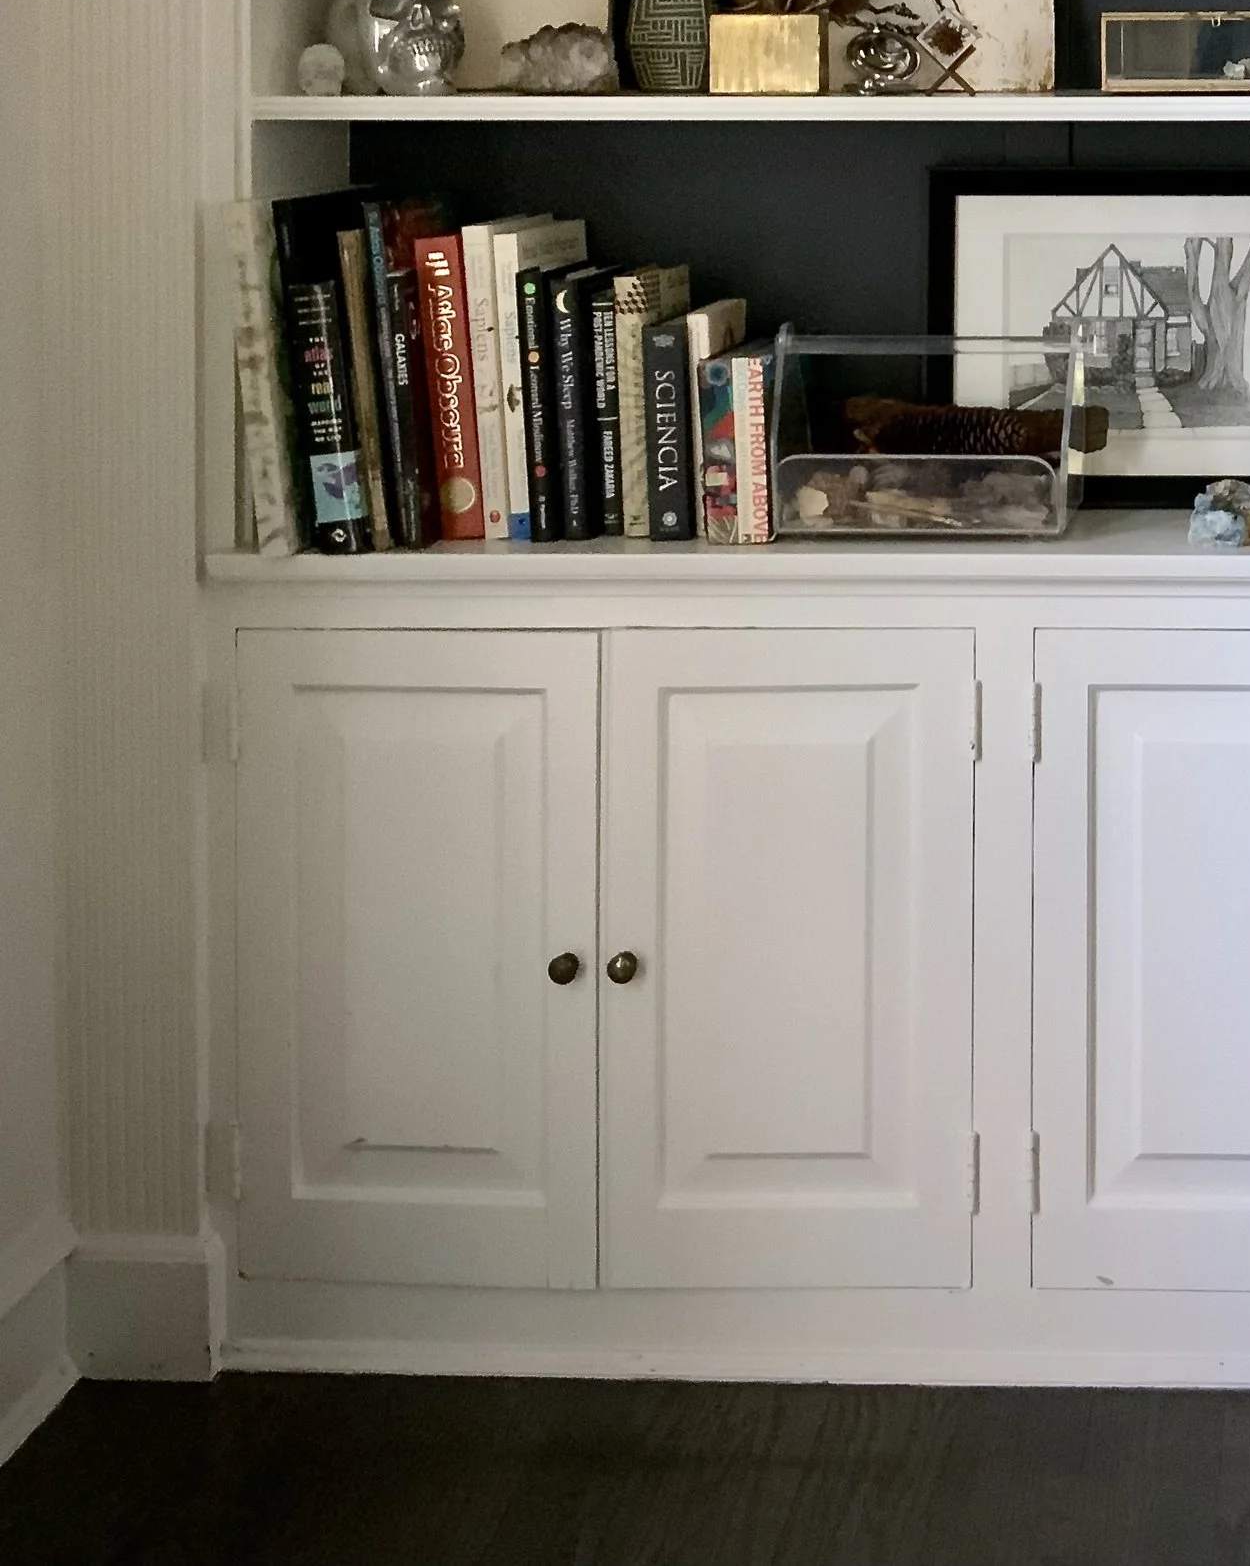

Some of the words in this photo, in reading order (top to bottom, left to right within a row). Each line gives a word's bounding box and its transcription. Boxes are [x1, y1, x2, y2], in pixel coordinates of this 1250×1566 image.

[427, 284, 456, 352] Atlas
[471, 298, 490, 362] Sapiens
[502, 312, 518, 364] Sapiens
[524, 297, 539, 349] Emotional
[557, 318, 572, 346] Why
[593, 311, 604, 377] POST-PANDEMIC
[603, 311, 614, 327] TEN
[394, 333, 408, 386] GALAXIES
[561, 351, 572, 372] We
[604, 328, 614, 365] LESSONS
[529, 365, 540, 409] Leonard
[560, 375, 574, 409] Sleep
[595, 379, 606, 409] WORLD
[605, 366, 615, 383] FOR
[747, 358, 763, 417] EARTH
[435, 353, 464, 469] Obscura
[654, 370, 678, 491] SCIENCIA
[603, 430, 614, 462] FAREED
[749, 422, 767, 476] FROM
[604, 464, 615, 498] ZAKARIA
[752, 482, 769, 543] ABOVE
